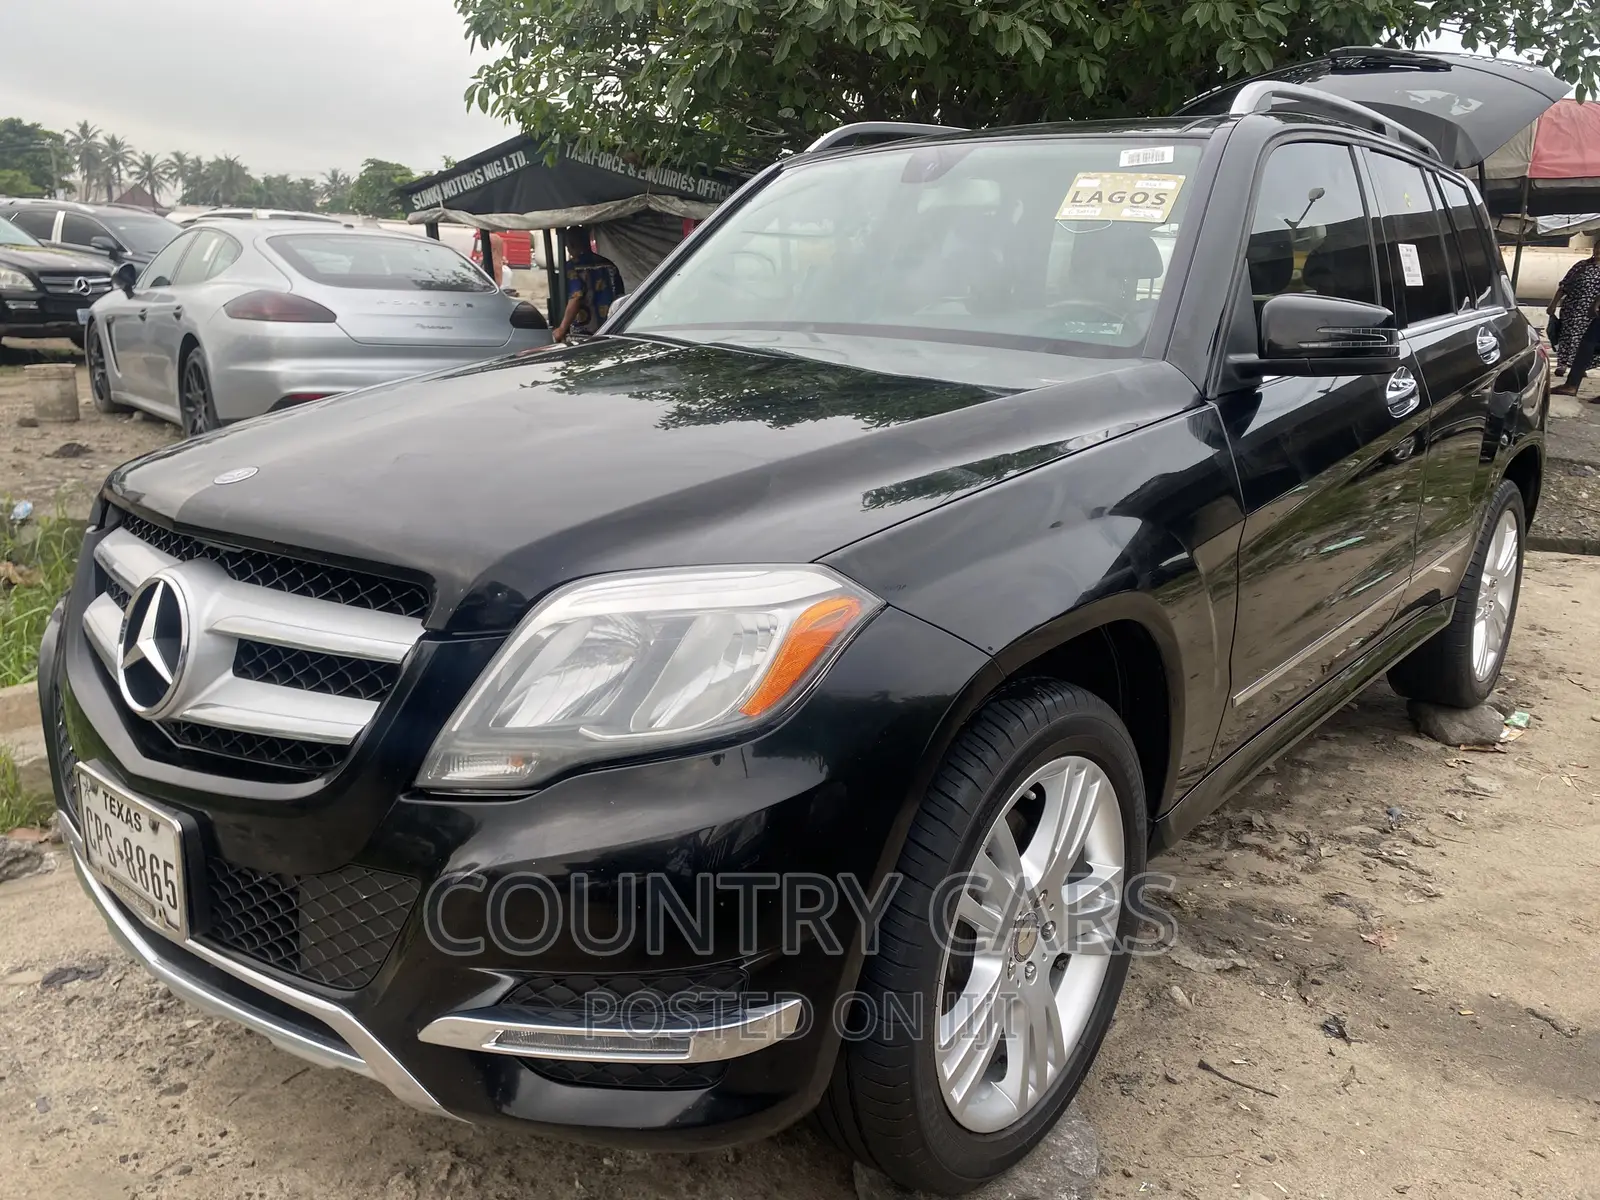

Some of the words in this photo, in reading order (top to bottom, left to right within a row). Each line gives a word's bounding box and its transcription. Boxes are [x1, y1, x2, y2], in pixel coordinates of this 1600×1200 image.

[440, 168, 485, 199] MOTORS
[1070, 190, 1168, 206] LAGOS
[103, 790, 142, 833] TEXAS
